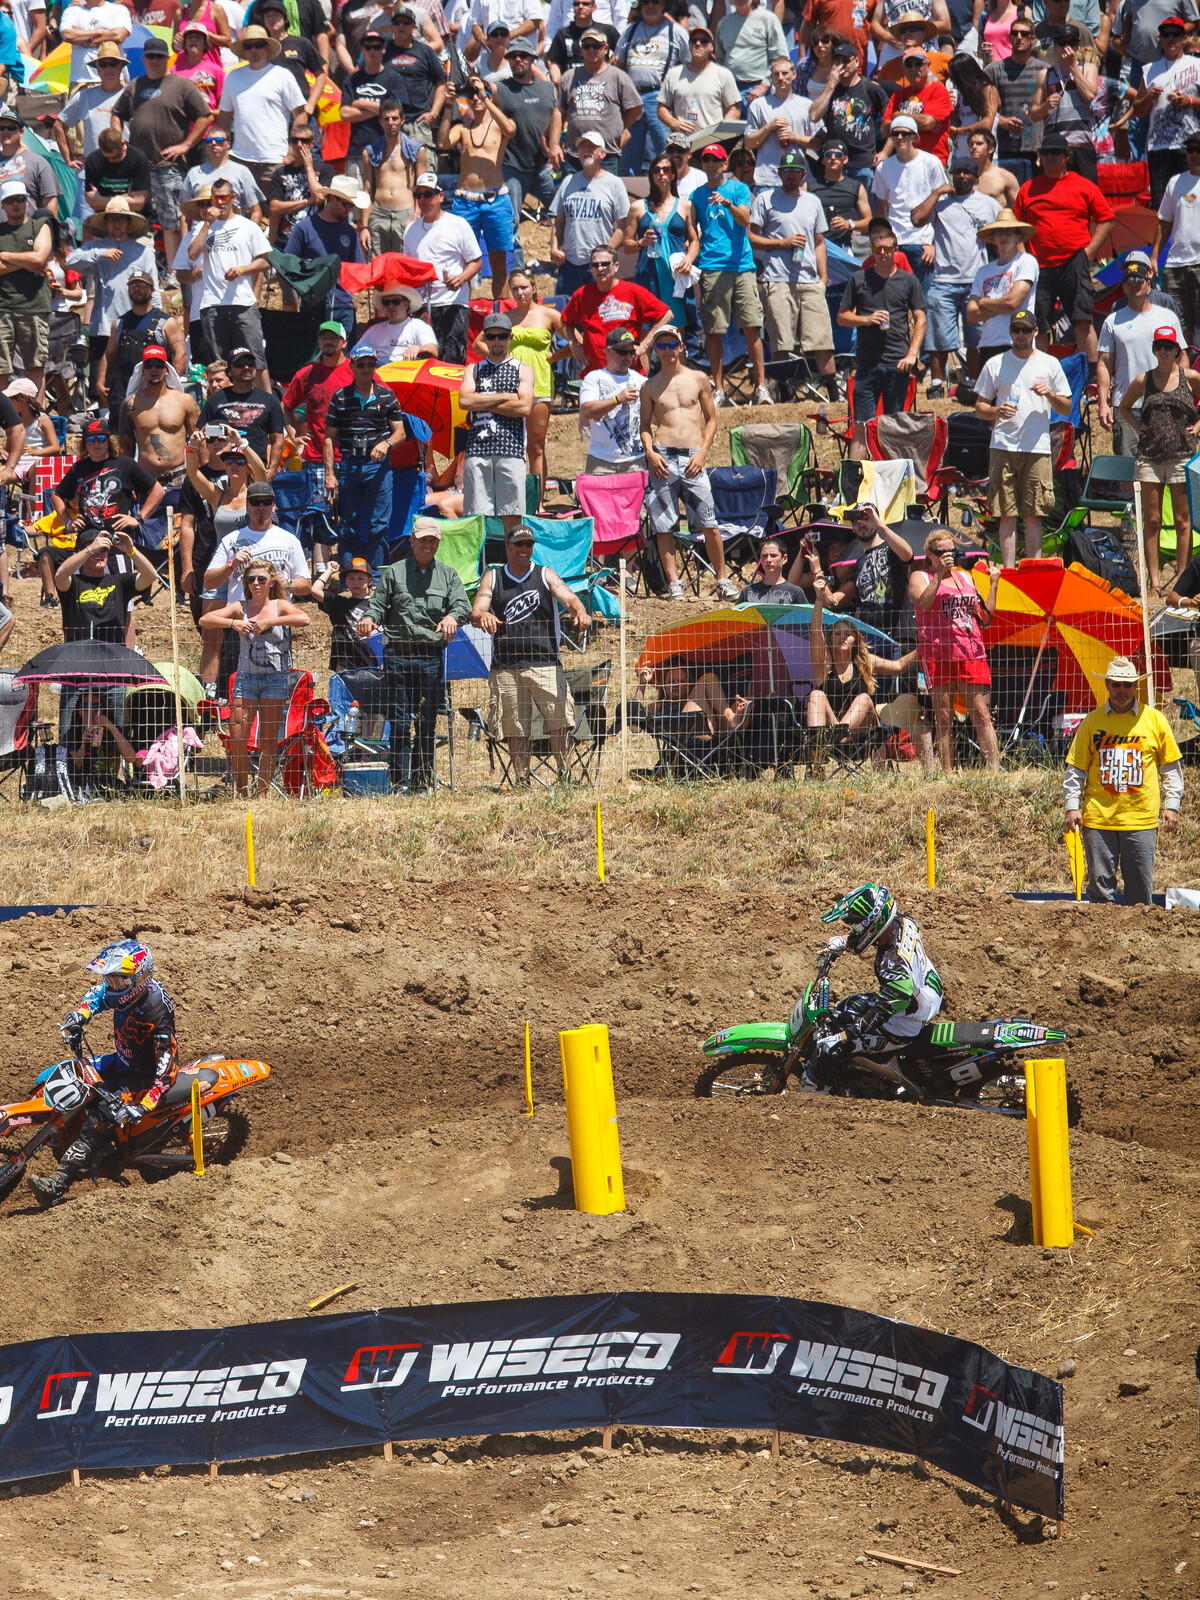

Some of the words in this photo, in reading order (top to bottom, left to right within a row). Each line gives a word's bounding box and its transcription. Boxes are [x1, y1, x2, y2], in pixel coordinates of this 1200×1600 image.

[1099, 748, 1142, 770] TRACK
[1101, 765, 1144, 790] CREW
[44, 1062, 82, 1109] 70
[950, 1062, 982, 1086] 9
[441, 1380, 568, 1398] Performance
[574, 1374, 656, 1389] Products
[104, 1410, 207, 1428] Performance
[211, 1402, 287, 1423] Products
[797, 1382, 884, 1409] Performance
[885, 1398, 935, 1423] Products
